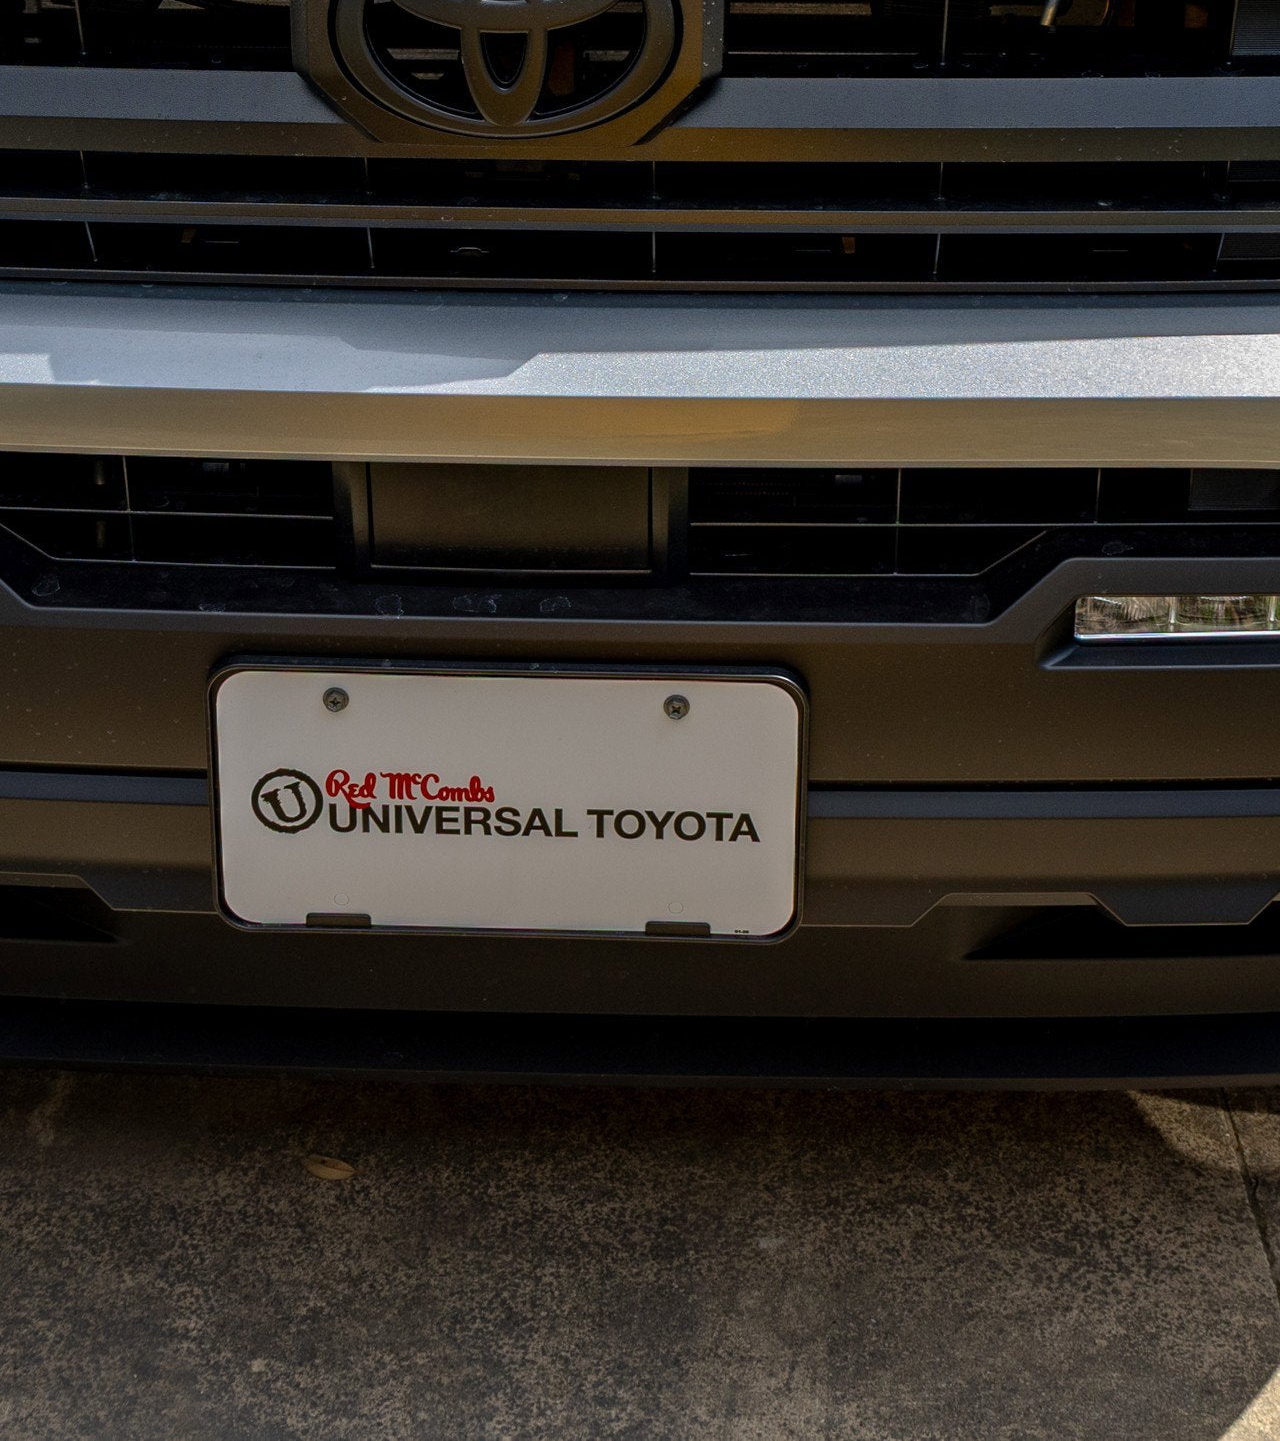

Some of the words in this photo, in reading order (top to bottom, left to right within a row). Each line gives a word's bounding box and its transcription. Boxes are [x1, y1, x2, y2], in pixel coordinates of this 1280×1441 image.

[325, 769, 377, 810] Red
[380, 770, 496, 803] McCombs
[328, 803, 579, 838] UNIVERSAL
[586, 808, 761, 843] TOYOTA
